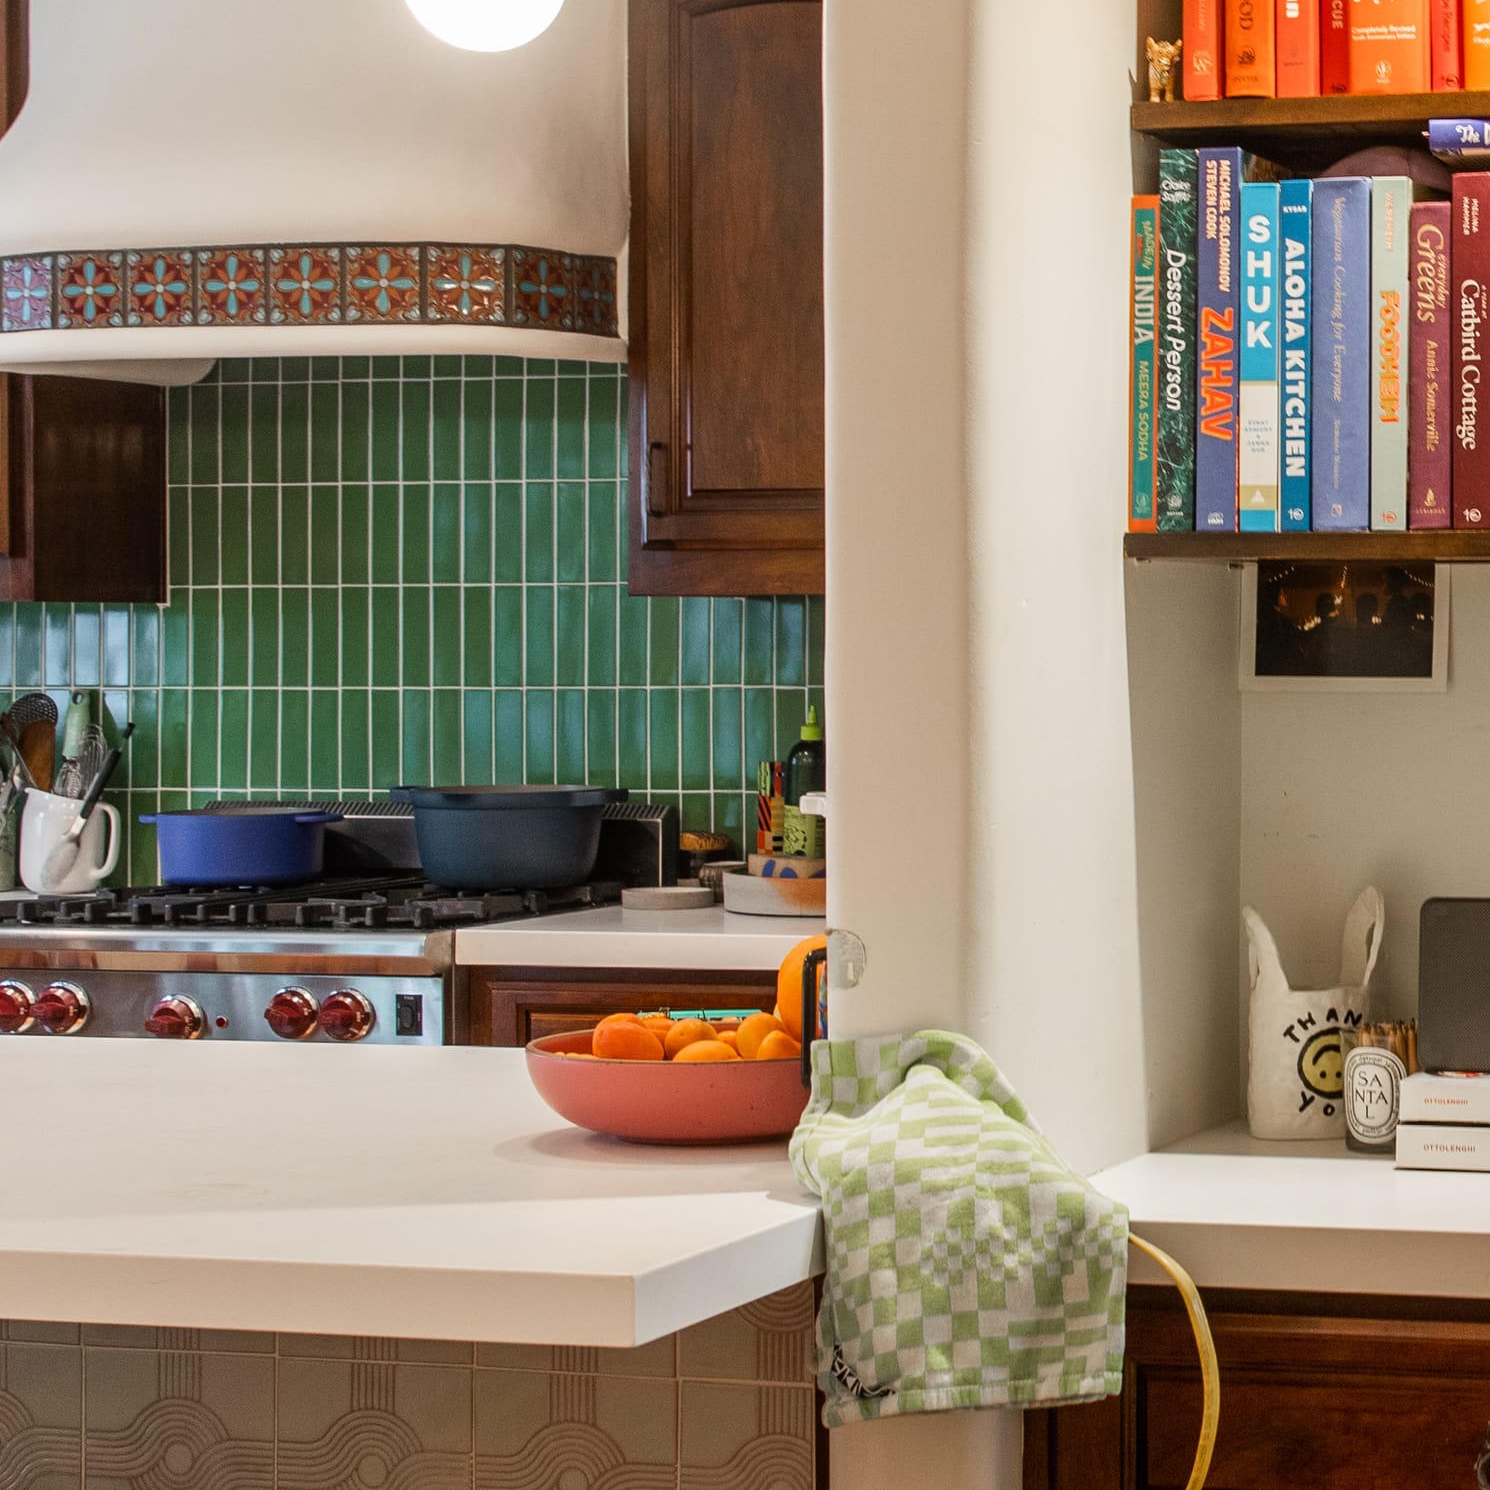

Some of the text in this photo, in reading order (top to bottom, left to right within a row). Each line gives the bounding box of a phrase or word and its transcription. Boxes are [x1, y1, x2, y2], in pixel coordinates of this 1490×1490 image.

[1455, 125, 1480, 144] The
[1205, 159, 1218, 239] STEVEN COOK
[1218, 159, 1231, 292] MICHAEL SOLOMONOV
[1246, 215, 1273, 349] SHUK
[1331, 265, 1346, 318] Cooking
[1415, 223, 1445, 323] Greens
[1435, 253, 1449, 309] everyday
[1134, 275, 1154, 346] INDIA
[1165, 249, 1187, 411] Dessert Person
[1330, 320, 1346, 340] for
[1200, 307, 1234, 441] ZAHAV
[1285, 237, 1306, 477] ALOHA KITCHEN
[1331, 344, 1345, 402] Everyone
[1378, 290, 1401, 423] FOODHEIM
[1456, 279, 1482, 450] Catbird Cottage
[1137, 360, 1150, 461] MEERA SODHA
[1425, 339, 1438, 452] Annie Somerville
[1283, 1008, 1363, 1043] THAN
[1299, 1091, 1336, 1116] YO
[1355, 1089, 1388, 1105] NTA
[1358, 1071, 1383, 1087] SA
[1424, 1097, 1469, 1106] OTTOLENGHI
[1423, 1144, 1476, 1153] OTTOLENGHI
